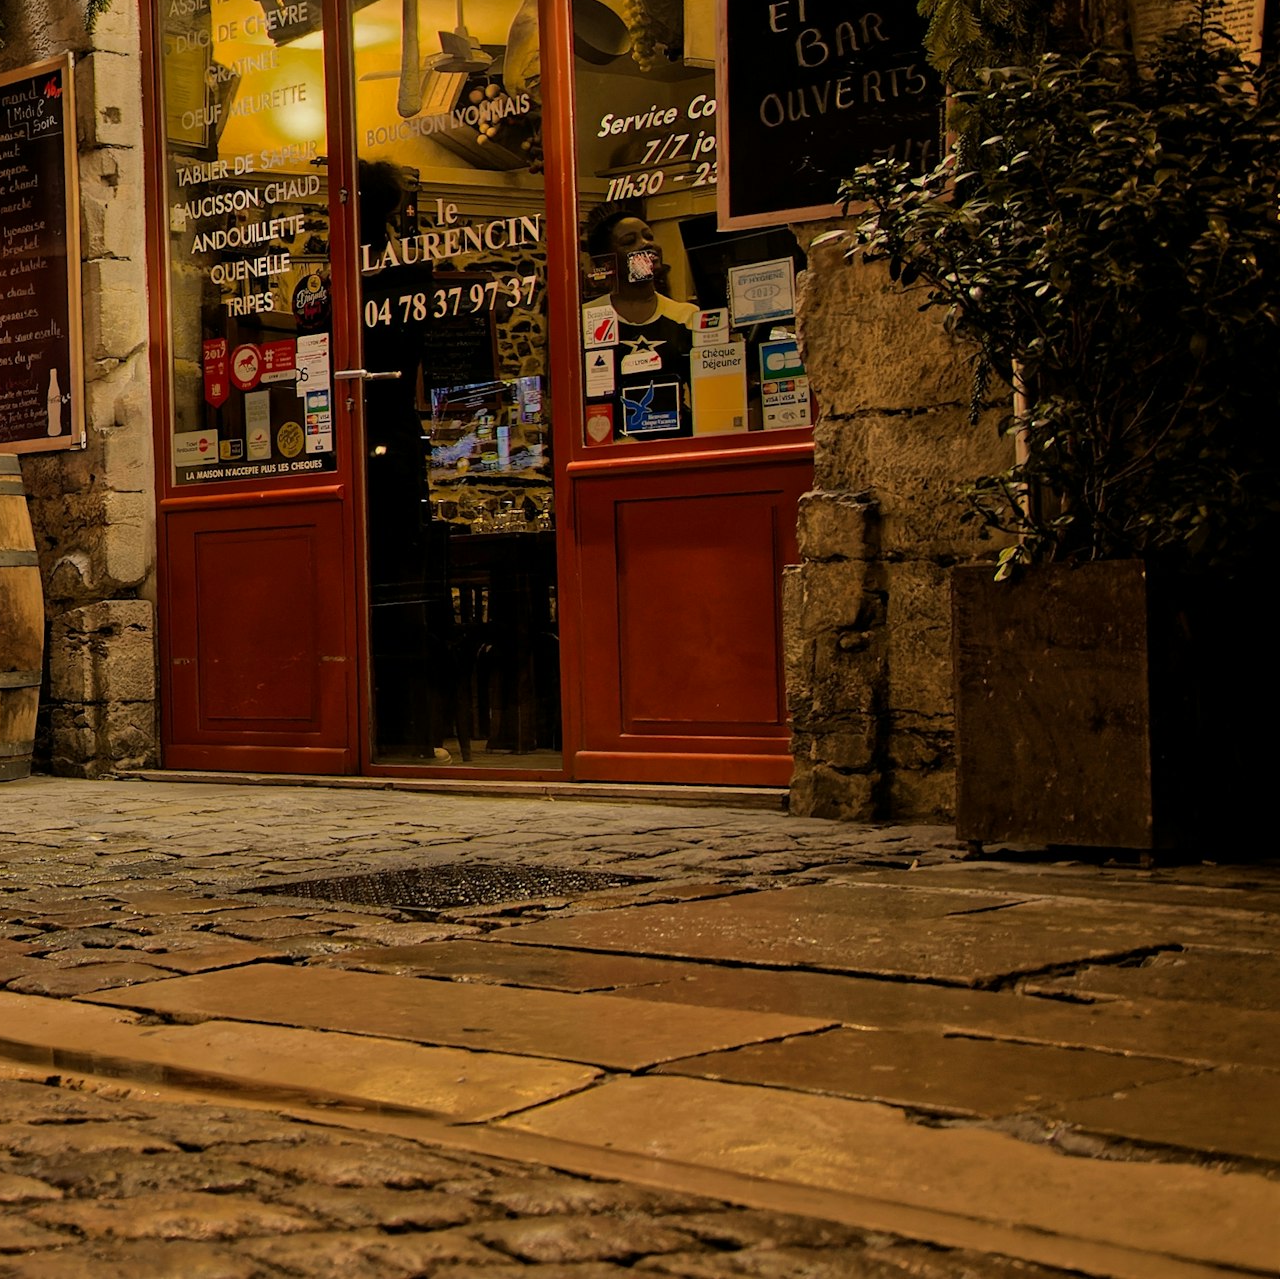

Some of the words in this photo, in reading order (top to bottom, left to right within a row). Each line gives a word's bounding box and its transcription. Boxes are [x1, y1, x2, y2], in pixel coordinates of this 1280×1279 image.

[217, 21, 238, 44] DE
[243, 1, 308, 36] CHEVRE
[795, 11, 891, 68] BAR
[181, 103, 222, 131] OEUF
[228, 82, 307, 117] MEURETTE
[759, 63, 927, 128] OUVERTS
[366, 116, 446, 148] BOUCHON
[450, 93, 530, 129] LYONNAIS
[598, 104, 678, 138] Service
[176, 160, 229, 188] TABLIER
[234, 153, 254, 176] DE
[260, 139, 318, 170] SAPEUR
[640, 133, 690, 165] 7/7
[690, 130, 717, 161] jo
[264, 175, 320, 205] CHAUD
[606, 170, 665, 202] 11h30
[435, 198, 459, 226] le
[191, 213, 306, 255] ANDOUILLETTE
[360, 213, 542, 272] LAURENCIN
[210, 252, 290, 285] QUENELLE
[226, 291, 274, 318] TRIPES
[364, 298, 392, 328] 04
[398, 292, 427, 323] 78
[433, 287, 462, 319] 37
[469, 281, 499, 313] 97
[506, 275, 537, 307] 37
[204, 346, 226, 361] 2017
[702, 348, 736, 360] Chèque
[702, 357, 742, 371] Déjeuner
[765, 396, 780, 404] VISA
[781, 394, 796, 403] VISA
[185, 471, 195, 481] LA
[196, 468, 224, 480] MAISON
[225, 464, 259, 477] N'ACCEPTE
[261, 463, 277, 474] PLUS
[278, 462, 290, 472] LES
[291, 459, 323, 471] CHEQUES
